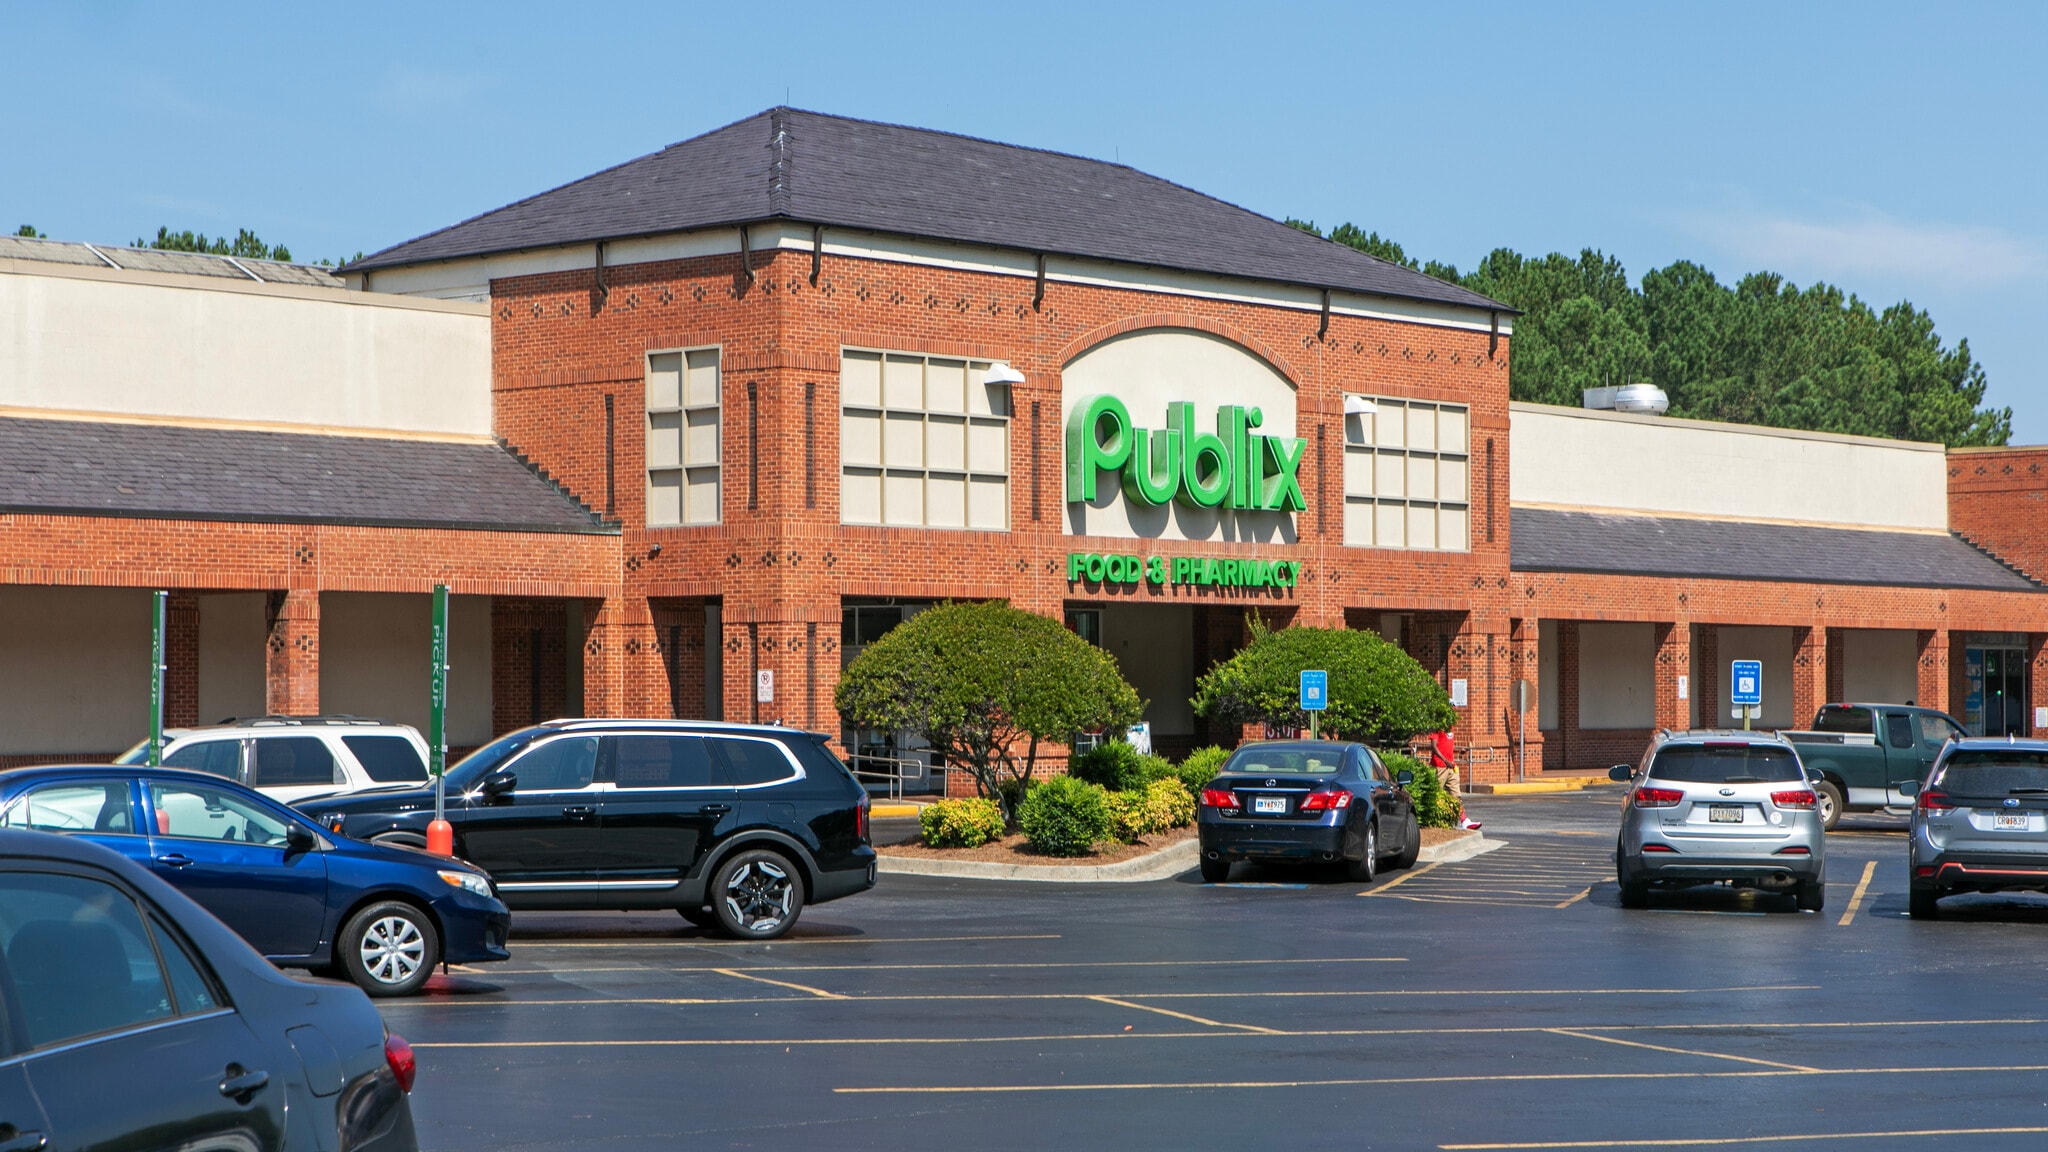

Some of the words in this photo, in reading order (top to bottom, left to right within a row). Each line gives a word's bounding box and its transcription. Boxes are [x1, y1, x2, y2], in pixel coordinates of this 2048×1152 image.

[1067, 393, 1308, 512] Publix
[1067, 553, 1142, 582] FOOD
[1145, 556, 1167, 584] &
[1171, 558, 1301, 588] PHARMACY
[432, 625, 440, 708] PICKUP
